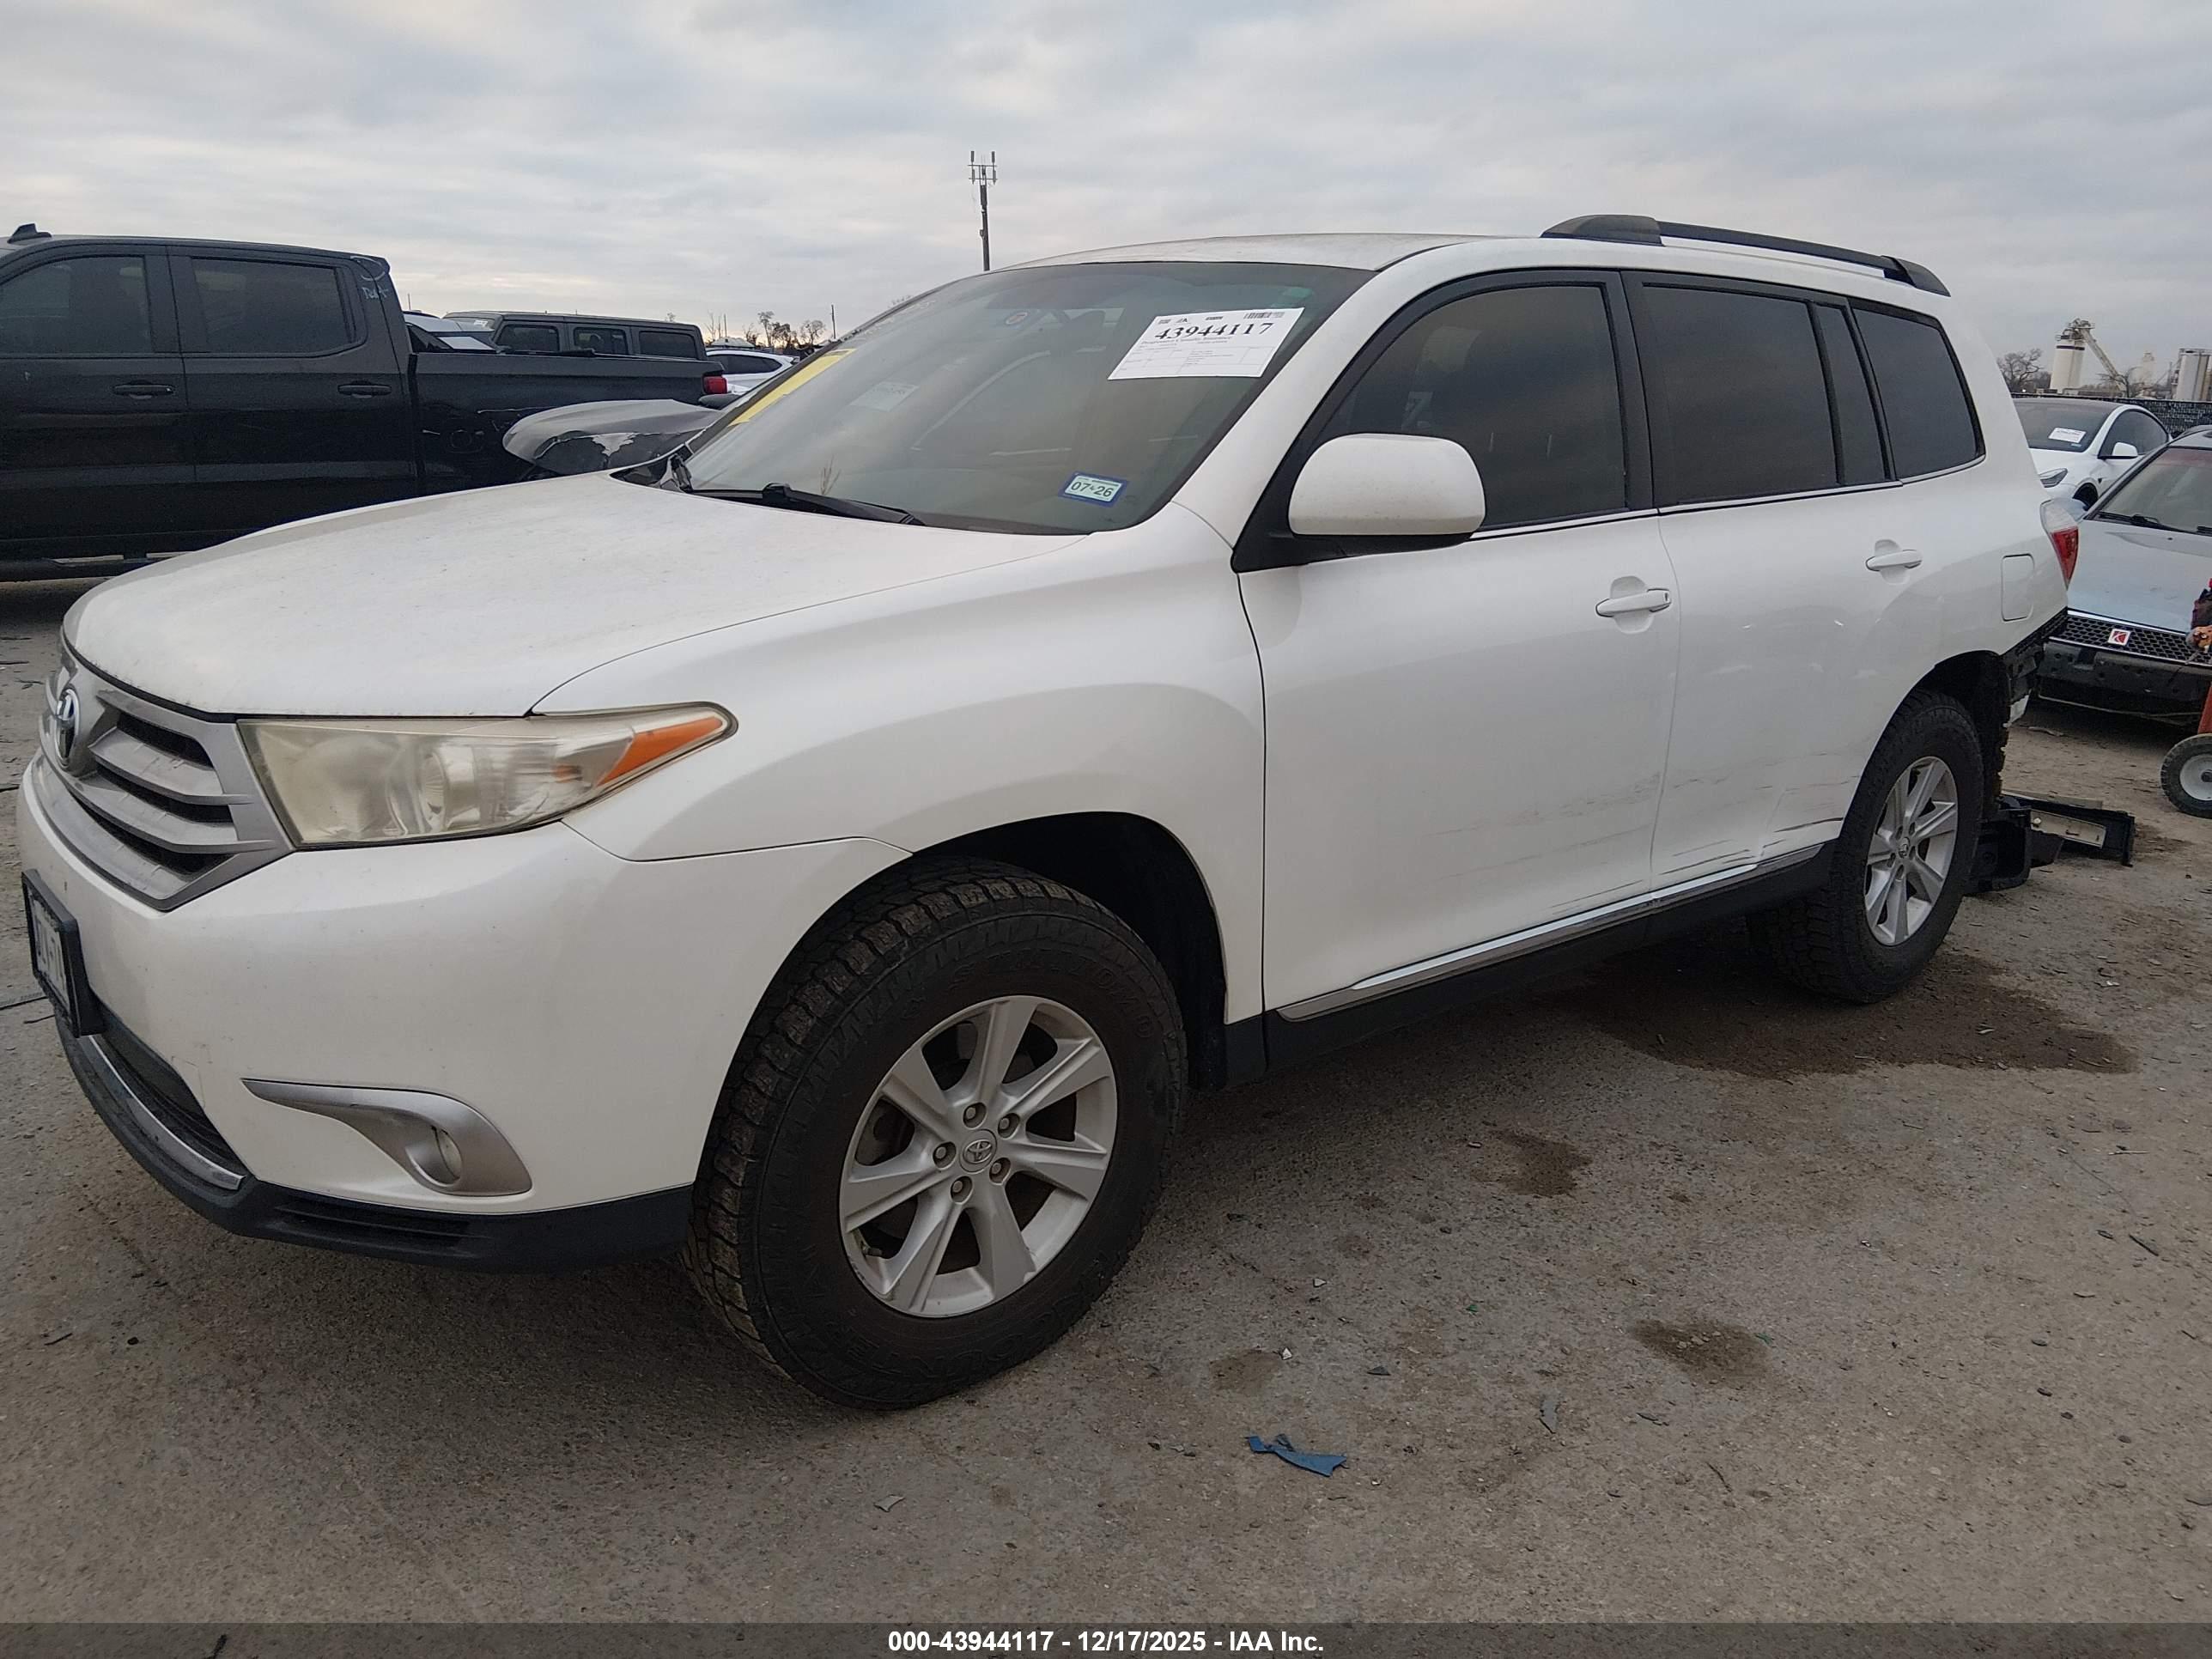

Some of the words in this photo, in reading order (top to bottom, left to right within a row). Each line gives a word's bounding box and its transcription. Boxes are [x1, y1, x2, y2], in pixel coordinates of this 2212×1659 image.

[1154, 322, 1274, 340] 43944117
[1071, 481, 1091, 492] 07
[1093, 486, 1114, 497] 26
